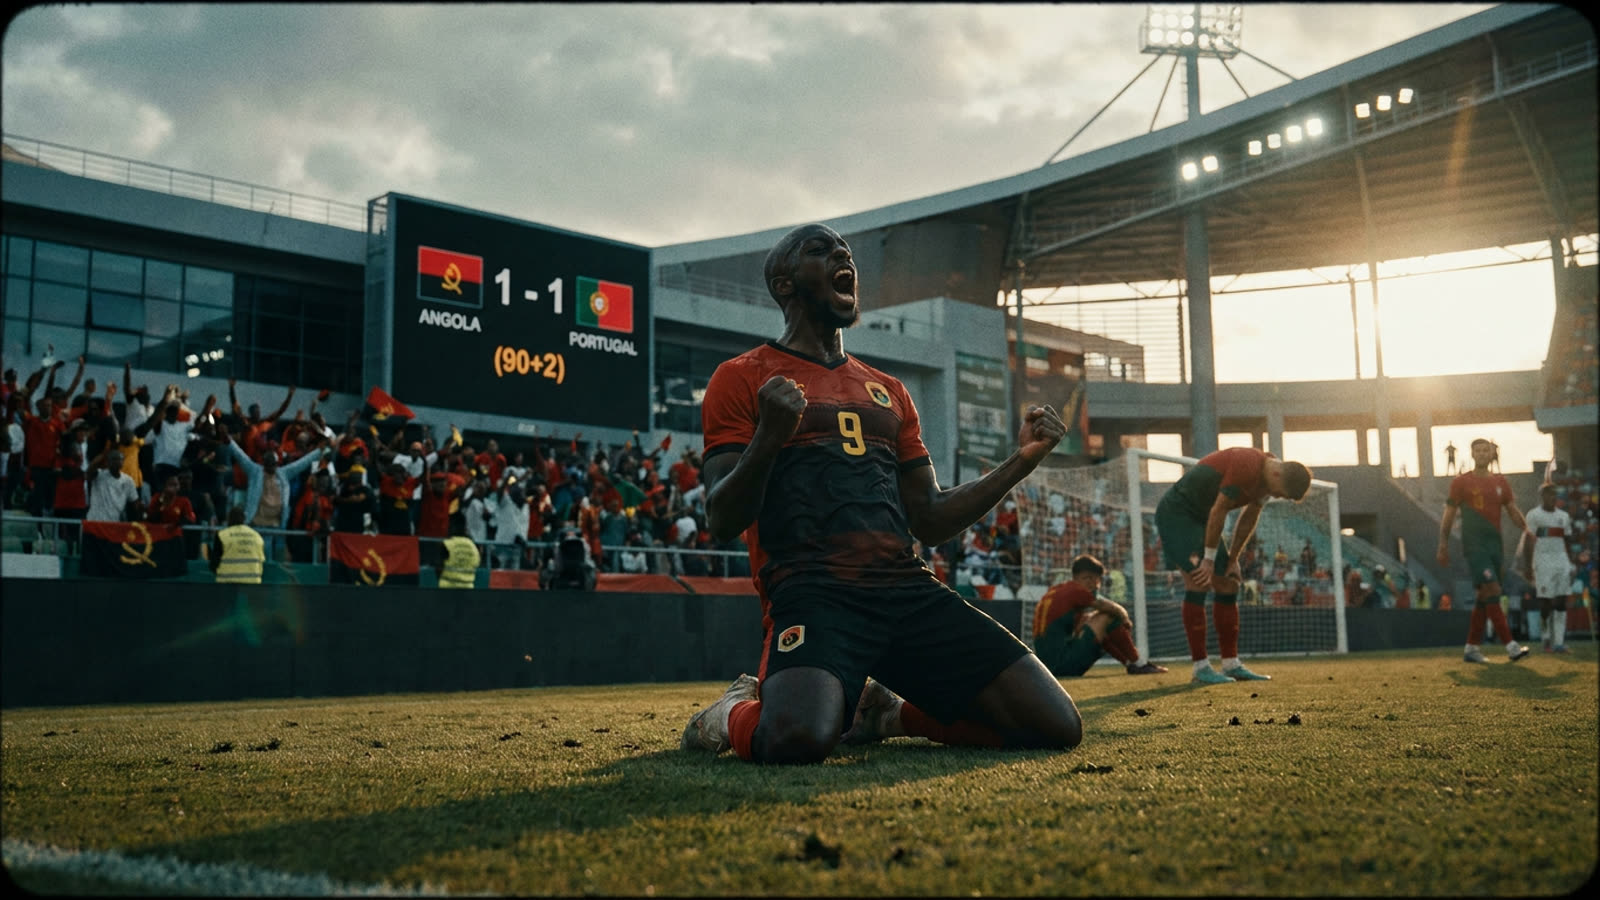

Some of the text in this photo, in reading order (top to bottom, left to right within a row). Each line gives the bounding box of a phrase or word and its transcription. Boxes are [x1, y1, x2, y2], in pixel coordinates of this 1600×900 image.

[494, 268, 511, 306] 1
[547, 277, 563, 314] 1
[418, 308, 482, 332] ANGOLA
[569, 331, 638, 356] PORTUGAL
[493, 345, 566, 385] (90+2)
[837, 411, 867, 456] 9
